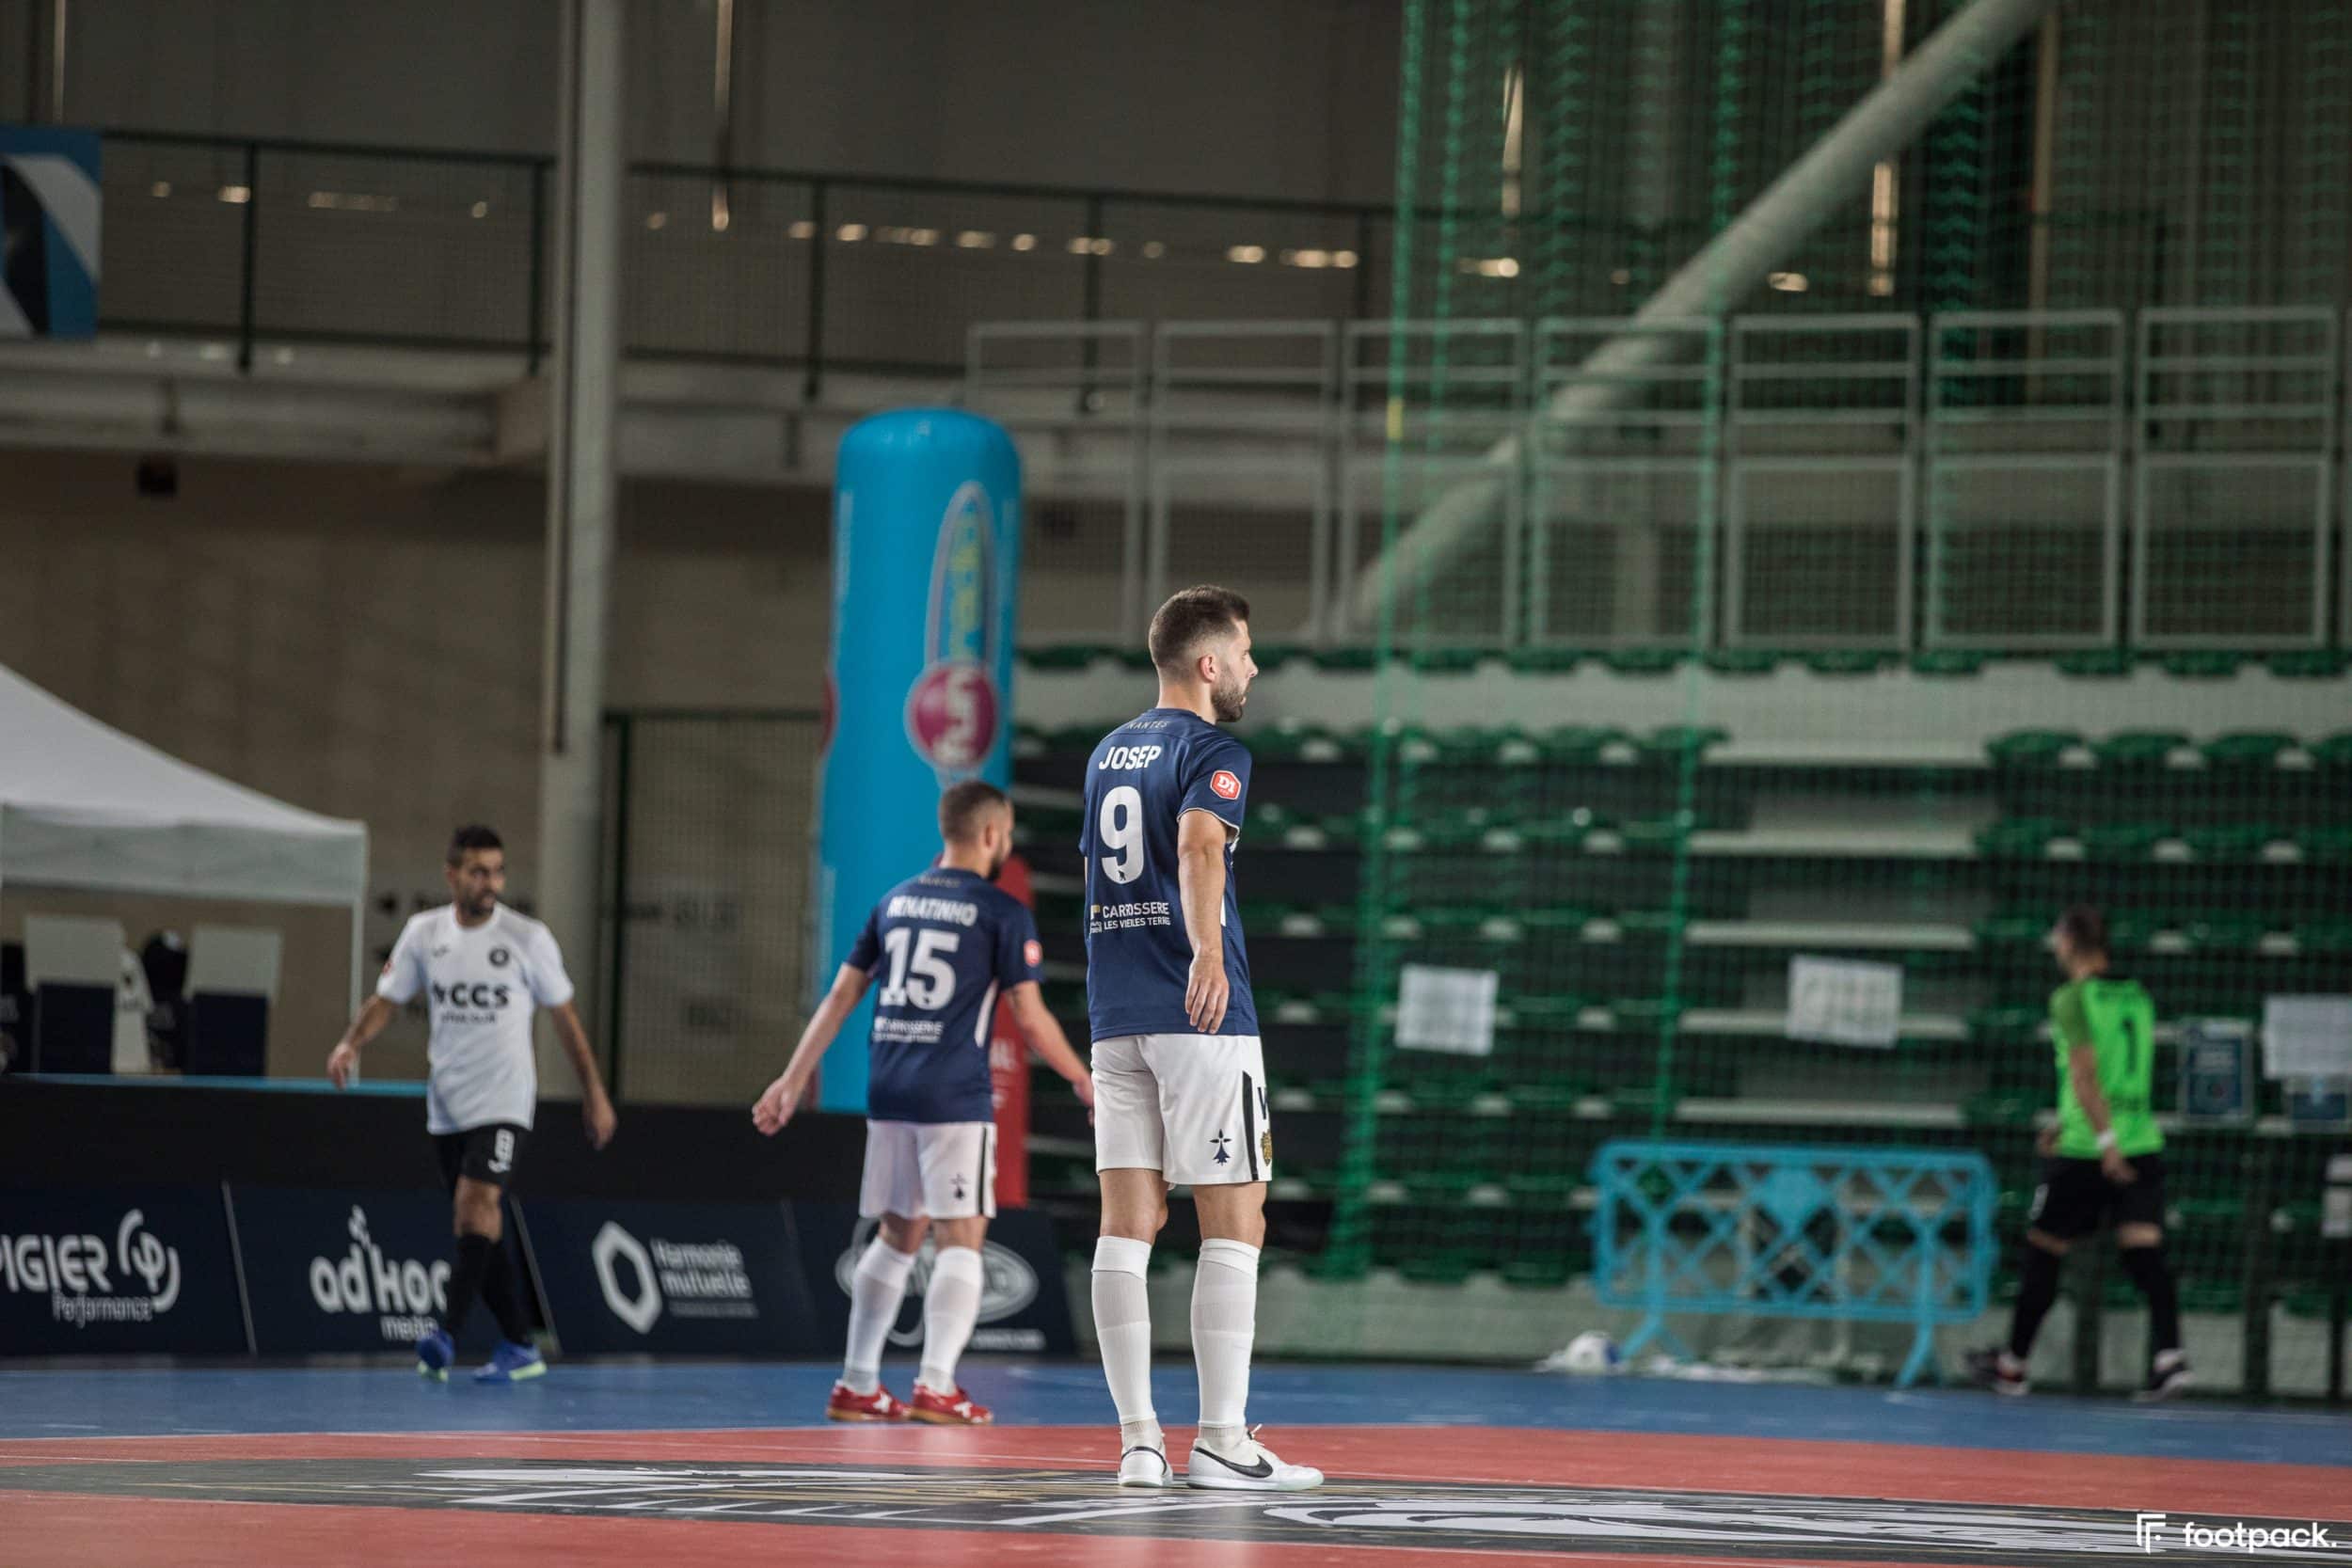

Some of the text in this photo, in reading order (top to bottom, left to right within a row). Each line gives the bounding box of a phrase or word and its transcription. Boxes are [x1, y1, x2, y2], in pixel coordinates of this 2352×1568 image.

[1098, 745, 1162, 770] JOSEP
[1099, 785, 1145, 885] 9
[1104, 920, 1119, 930] LES
[879, 926, 961, 1011] 15
[0, 1234, 113, 1293] IGIER
